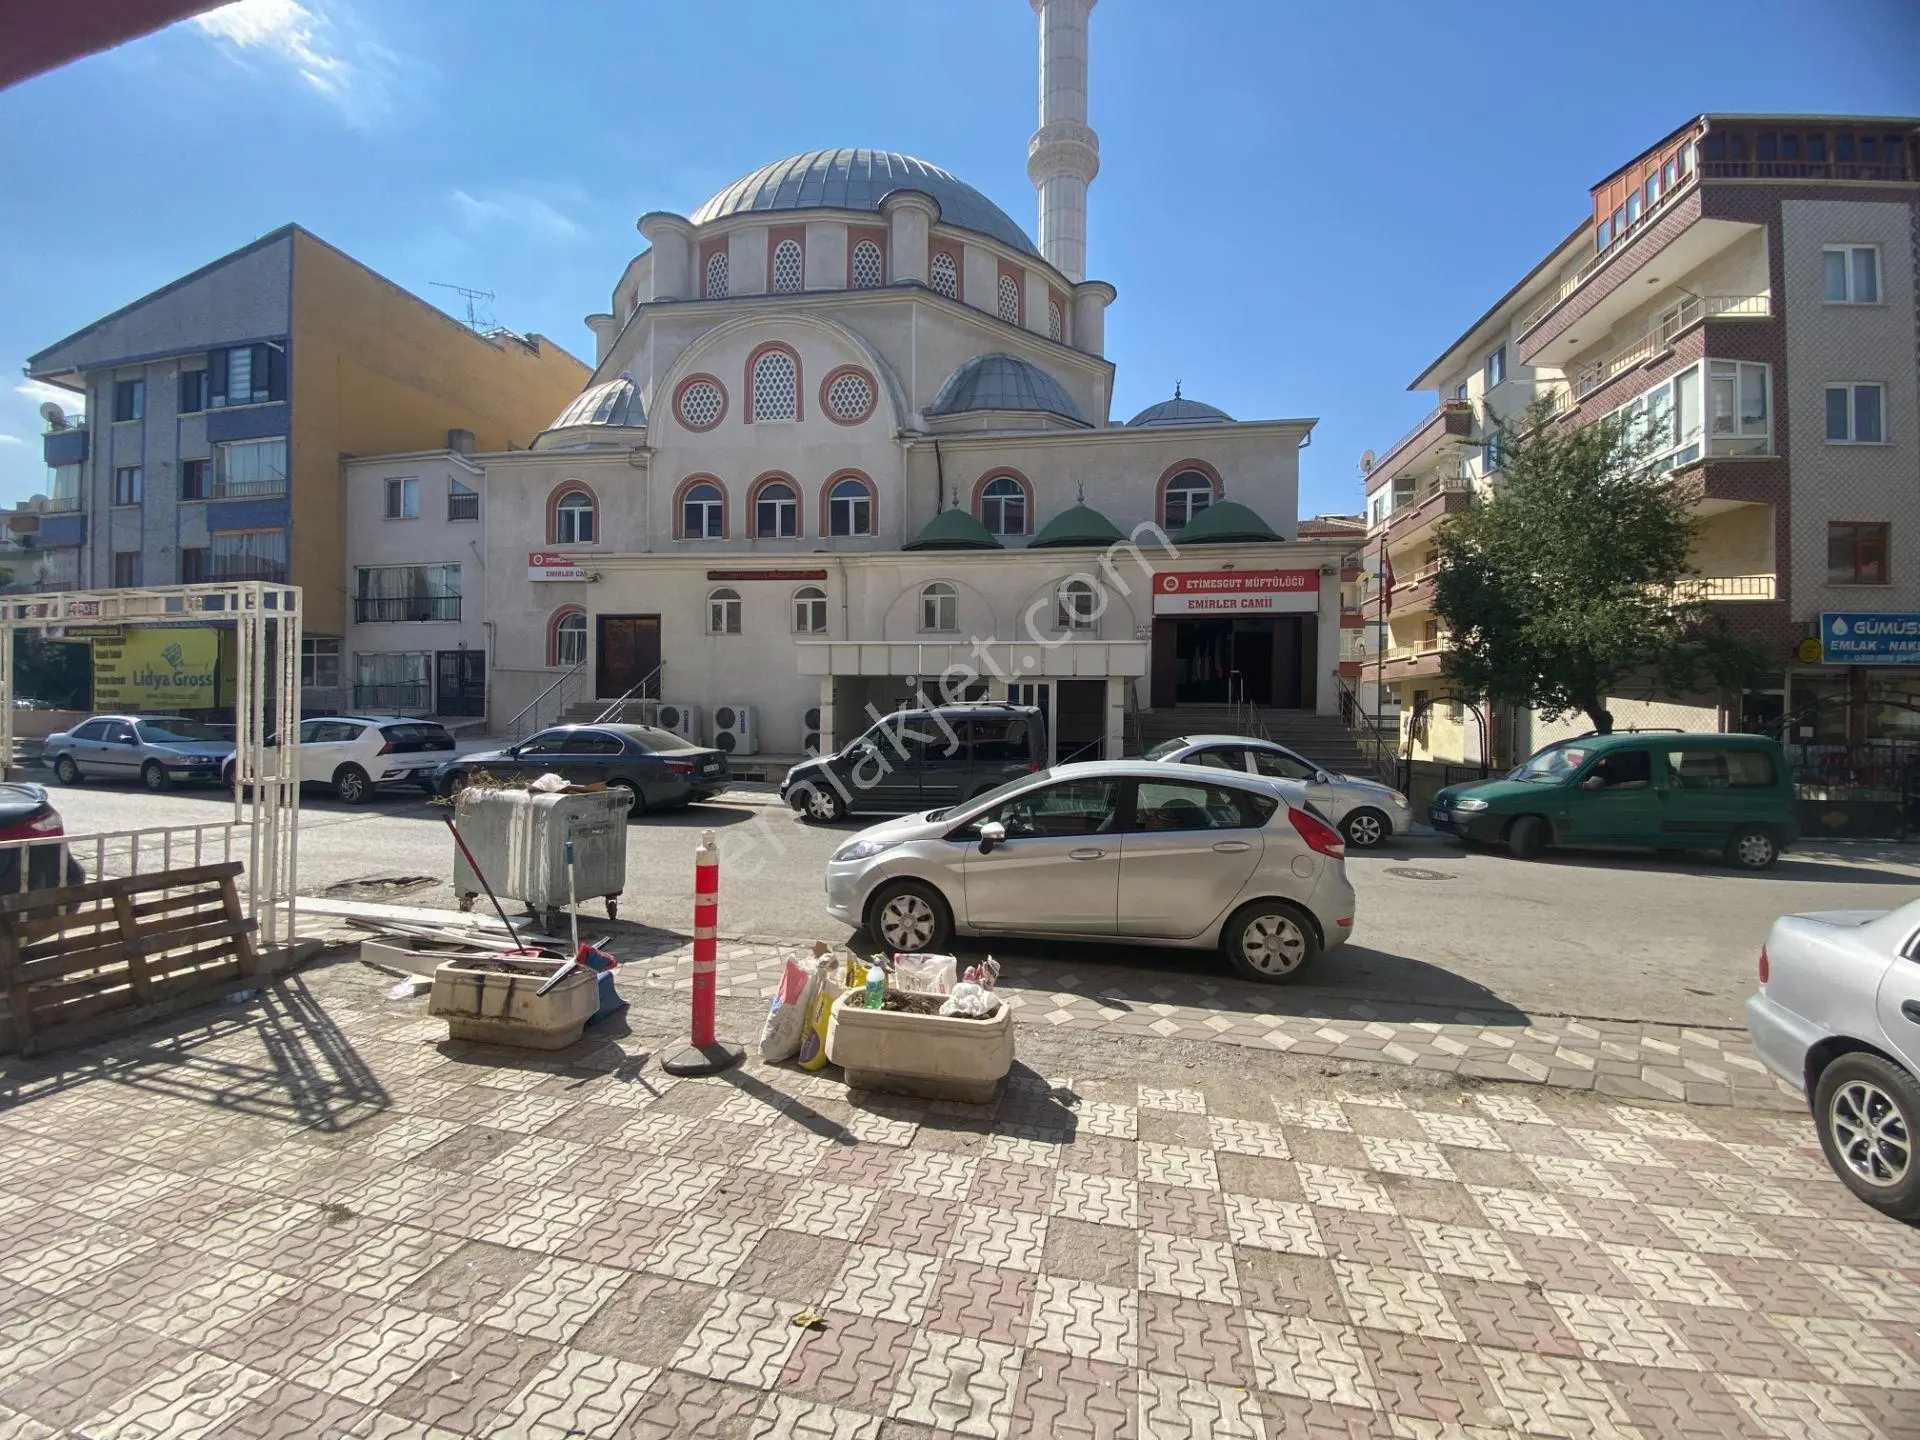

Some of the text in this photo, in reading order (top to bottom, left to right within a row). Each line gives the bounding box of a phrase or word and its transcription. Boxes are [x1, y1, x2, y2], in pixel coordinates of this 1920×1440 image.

[1186, 576, 1305, 589] ETİMESGUT MÜFTÜLÜĞÜ
[1188, 597, 1273, 609] EMİRLER CAMİİ
[1854, 618, 1920, 637] GÜMÜŞ
[1831, 640, 1877, 651] EMLAK
[133, 670, 169, 690] Lidya
[173, 671, 213, 687] Gross
